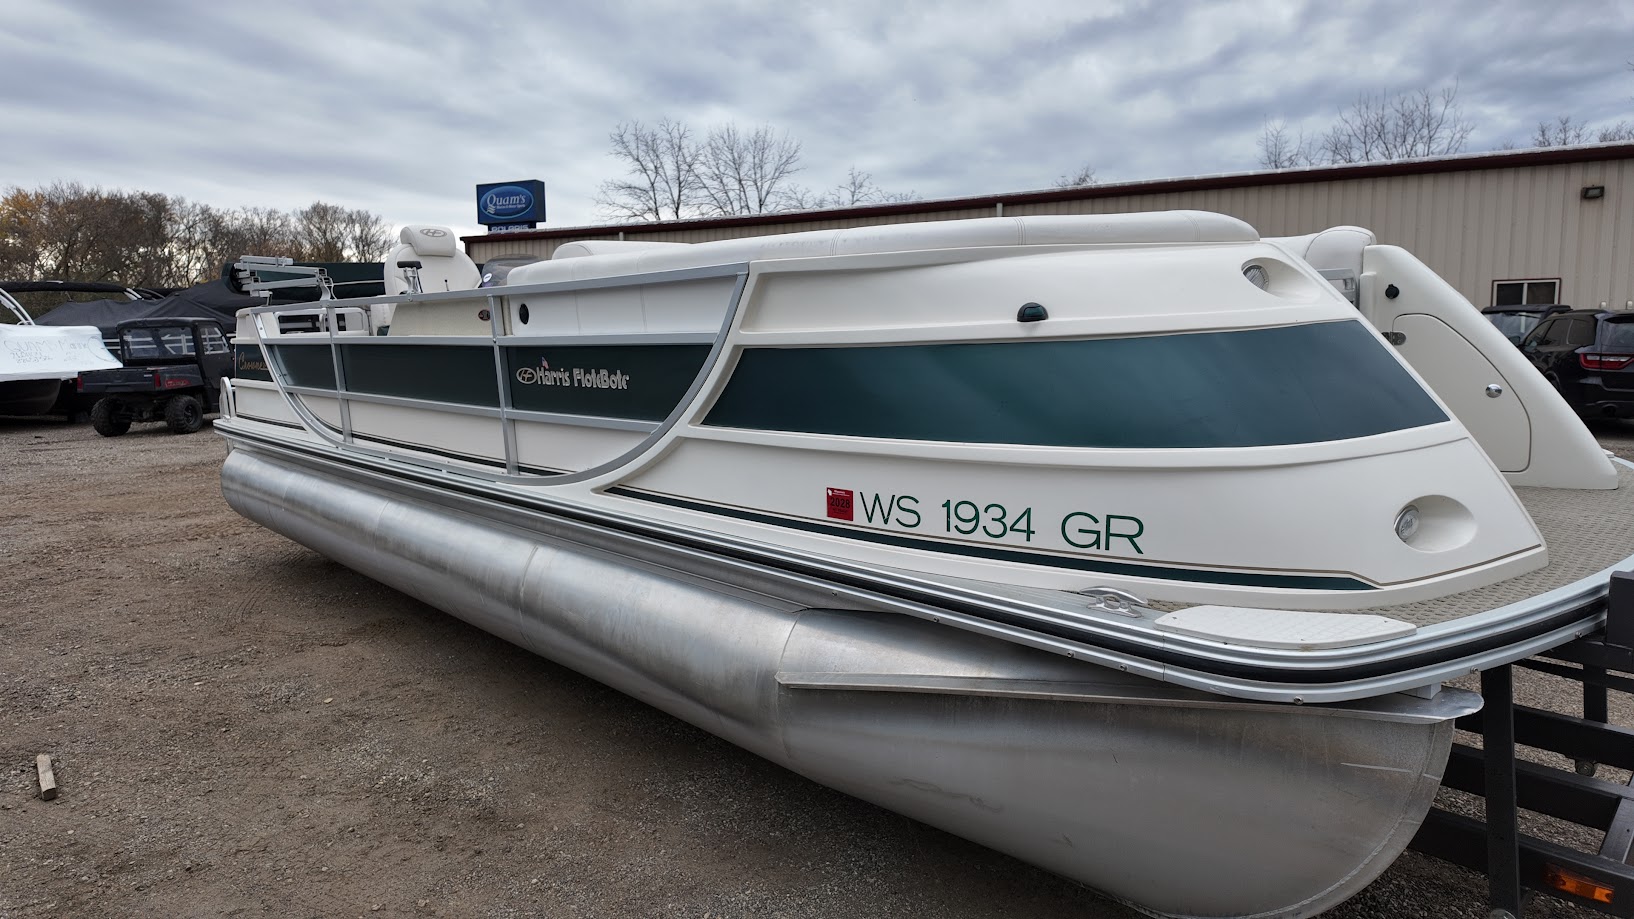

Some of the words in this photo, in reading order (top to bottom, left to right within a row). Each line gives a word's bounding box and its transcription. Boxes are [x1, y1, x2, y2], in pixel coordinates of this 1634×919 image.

[487, 194, 526, 209] Quam's
[536, 367, 570, 387] Harris
[830, 497, 851, 509] 2028
[859, 491, 922, 527] WS
[941, 499, 1036, 542] 1934
[1061, 511, 1144, 555] GR
